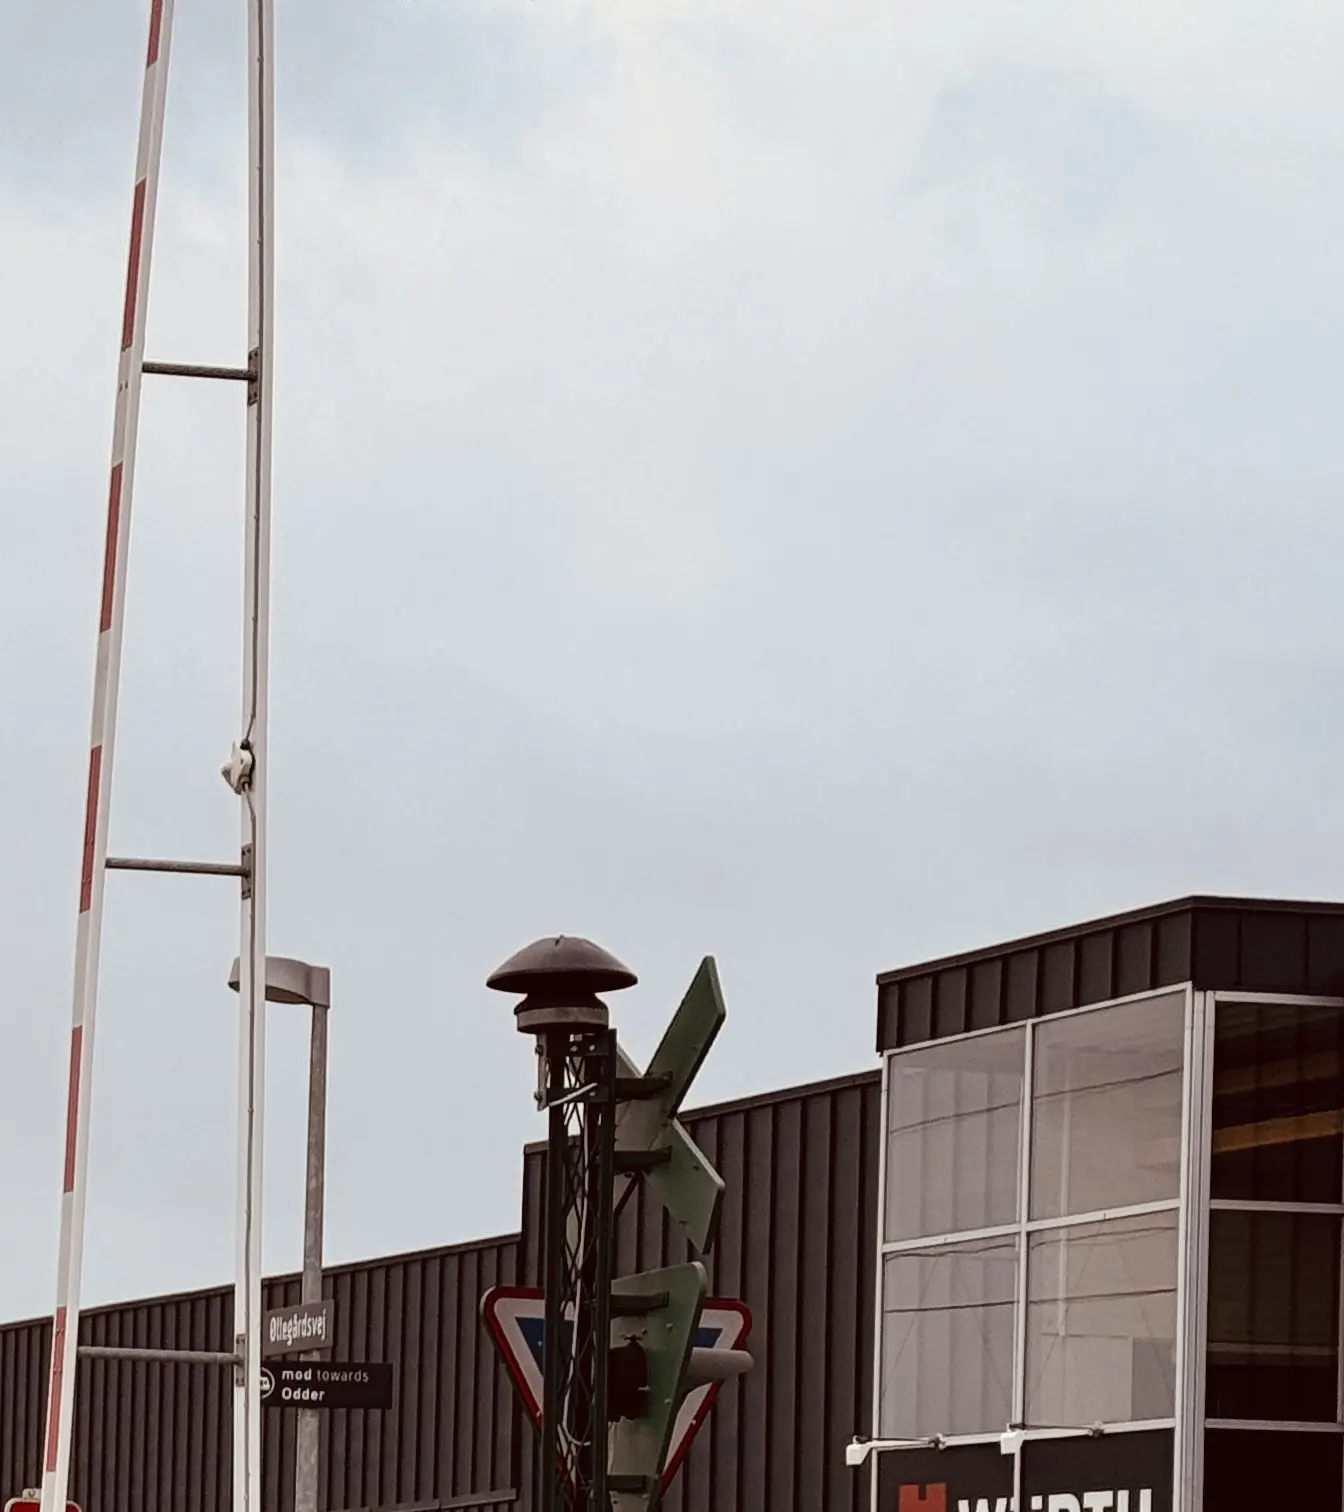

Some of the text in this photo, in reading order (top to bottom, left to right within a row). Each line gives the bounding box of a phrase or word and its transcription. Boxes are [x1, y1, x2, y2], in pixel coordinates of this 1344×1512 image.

[282, 1368, 369, 1383] mod towards
[282, 1387, 325, 1401] Odder
